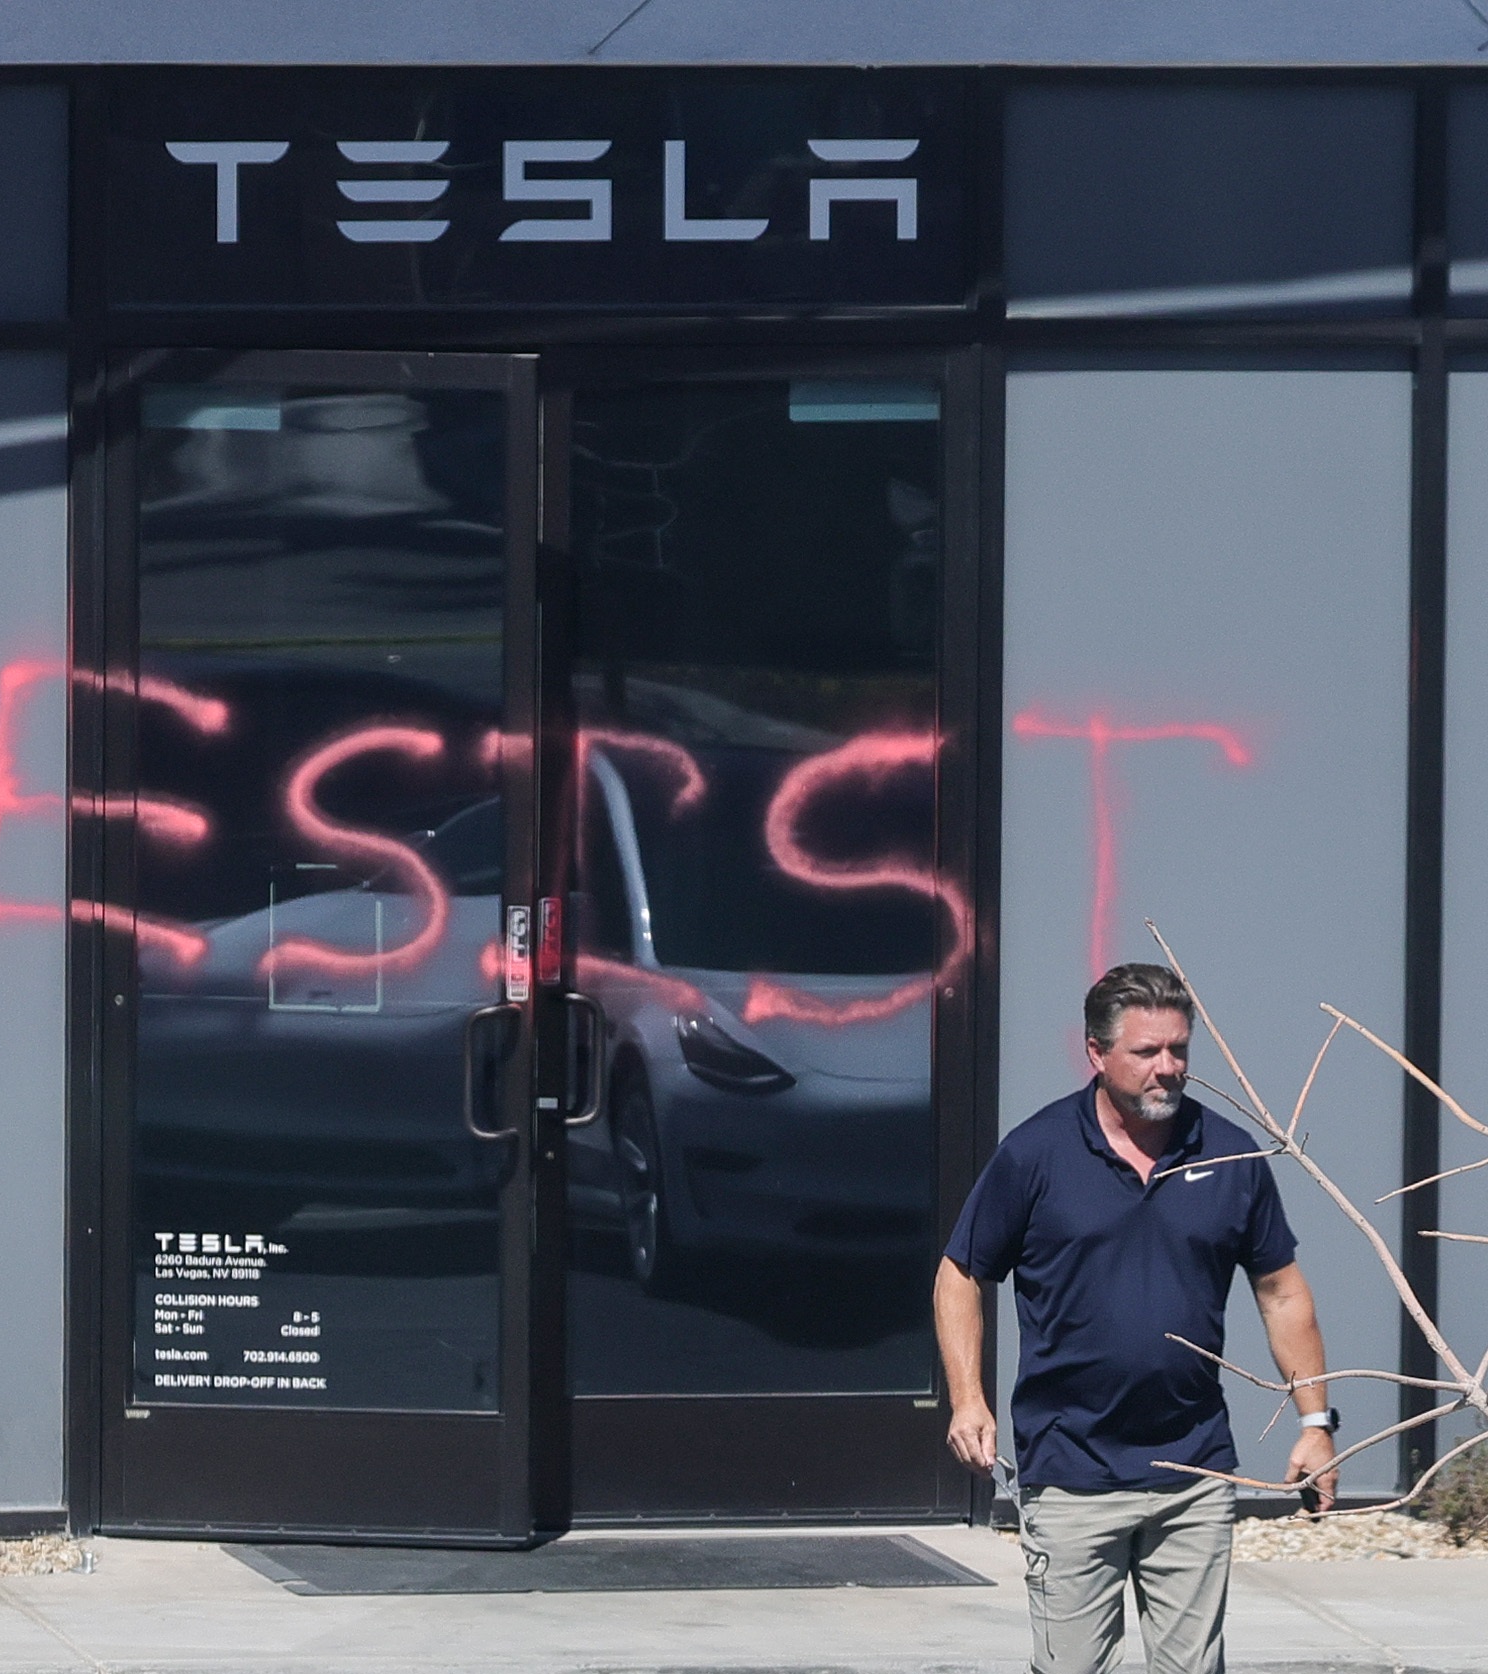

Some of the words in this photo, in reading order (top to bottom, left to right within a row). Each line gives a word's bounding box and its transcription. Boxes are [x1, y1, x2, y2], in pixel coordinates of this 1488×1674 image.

[164, 138, 922, 243] TESLA
[512, 911, 527, 963] PULL
[155, 1254, 183, 1267] 6260
[185, 1254, 222, 1267] Badura
[155, 1267, 174, 1279] Las
[212, 1269, 230, 1280] NV
[155, 1294, 217, 1306] COLLISION
[218, 1295, 260, 1307] HOURS
[155, 1309, 178, 1321] Mon
[188, 1310, 204, 1321] Fri
[311, 1311, 320, 1323] 5
[155, 1323, 173, 1335] Sat
[183, 1323, 204, 1335] Sun
[281, 1324, 321, 1337] Closed
[155, 1348, 209, 1361] tesla.com
[155, 1375, 211, 1388] DELIVERY
[213, 1376, 276, 1389] DROP-OFF
[277, 1377, 292, 1389] IN
[293, 1378, 327, 1390] BACK
